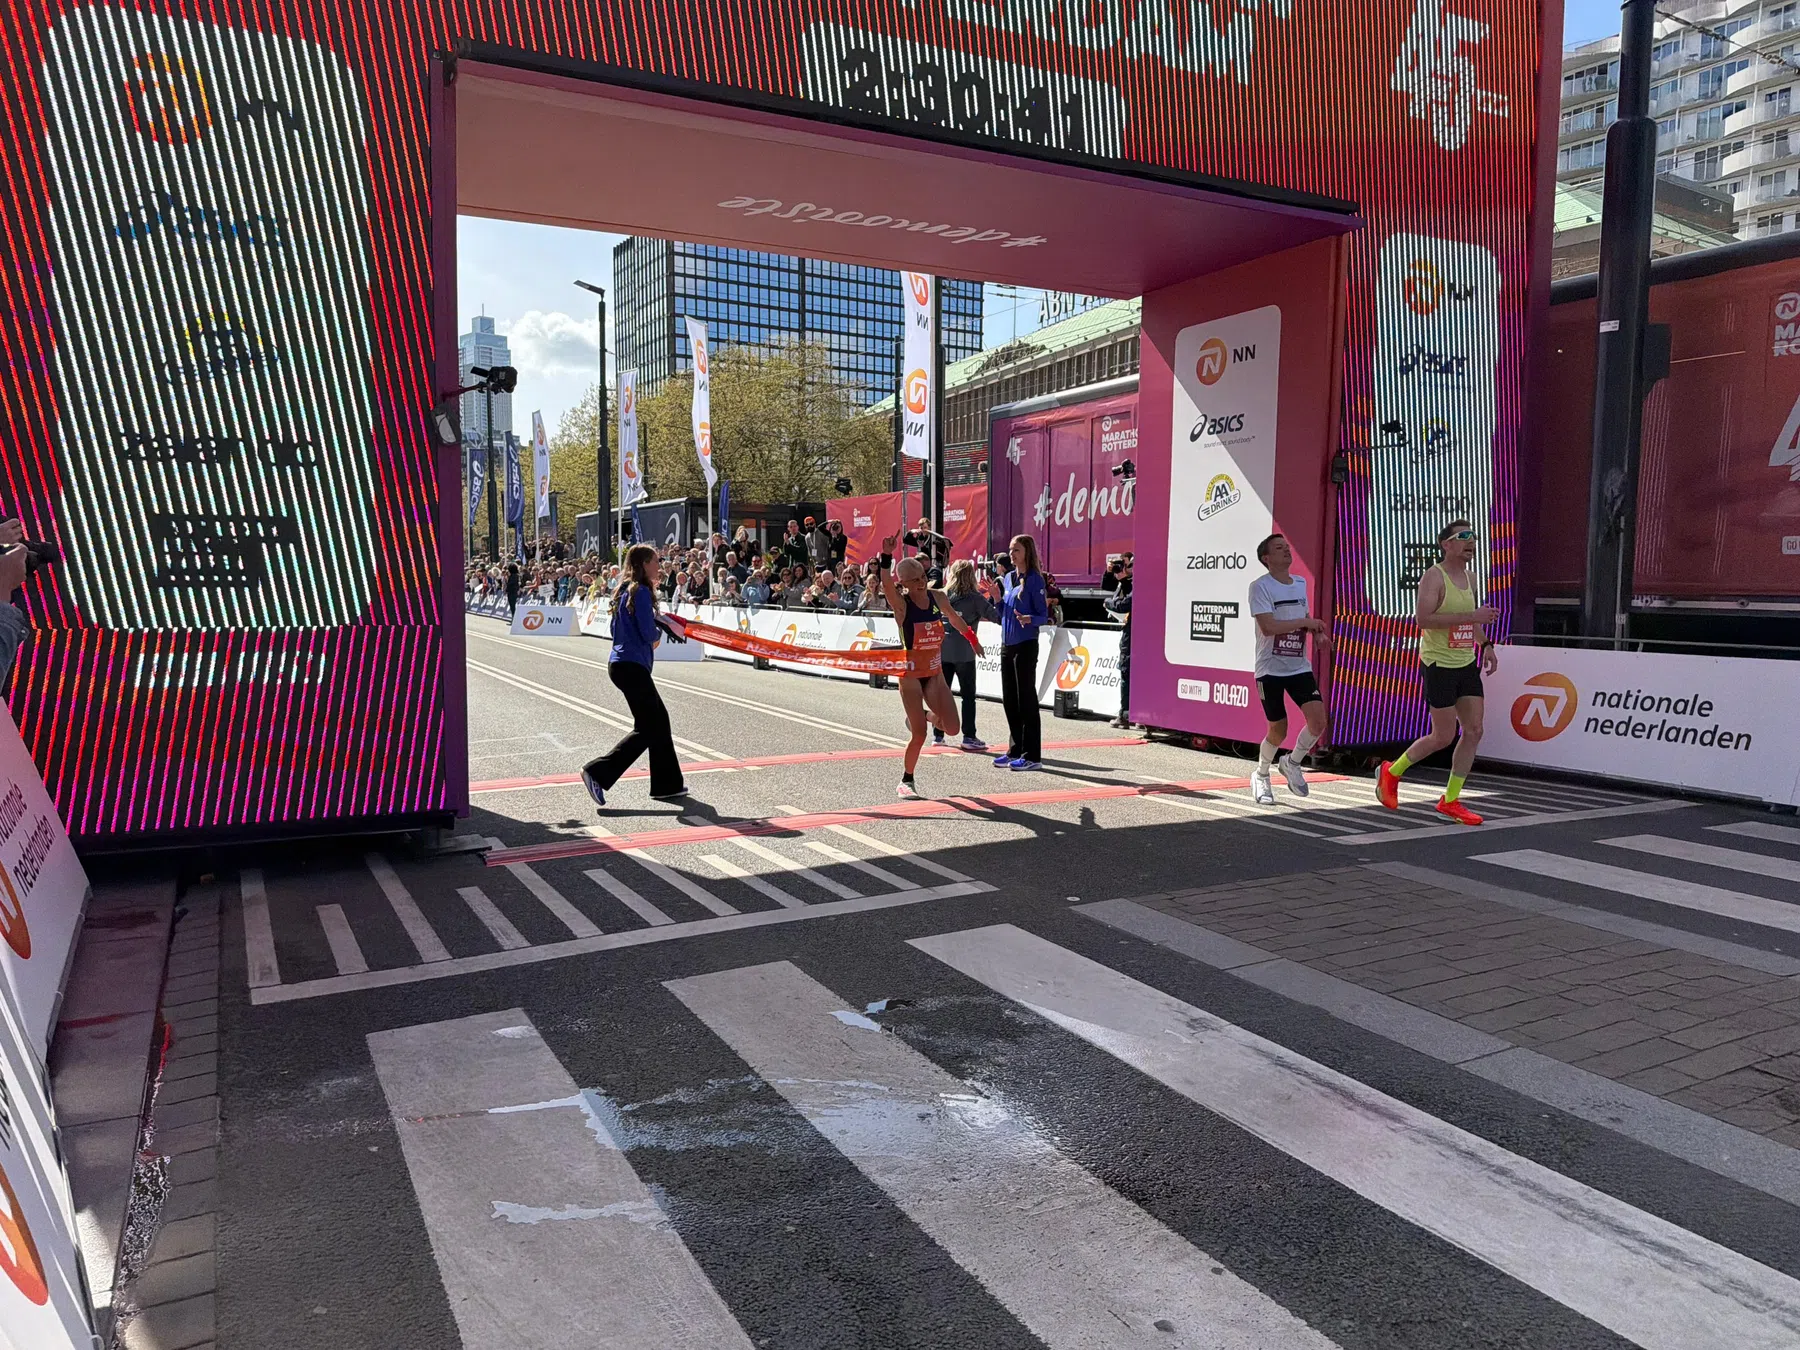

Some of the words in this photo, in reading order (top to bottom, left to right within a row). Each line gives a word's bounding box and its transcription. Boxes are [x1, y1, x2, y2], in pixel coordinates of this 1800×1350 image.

[717, 195, 1047, 249] #demooiste
[1038, 290, 1075, 323] ABN
[1233, 344, 1256, 363] NN
[1207, 413, 1245, 435] asics
[470, 476, 482, 511] asics
[1210, 494, 1234, 513] DRINK
[1214, 483, 1229, 503] AA
[1187, 552, 1247, 569] zalando
[1193, 604, 1236, 615] ROTTERDAM.
[1193, 614, 1212, 623] MAKE
[1214, 614, 1221, 623] IT
[1193, 623, 1222, 632] HAPPEN.
[1181, 684, 1188, 694] GO
[1188, 685, 1202, 696] WITH
[1214, 682, 1249, 707] GOLAZO
[1592, 689, 1714, 717] nationale
[1584, 716, 1752, 751] nederlanden
[13, 814, 56, 897] nederlanden
